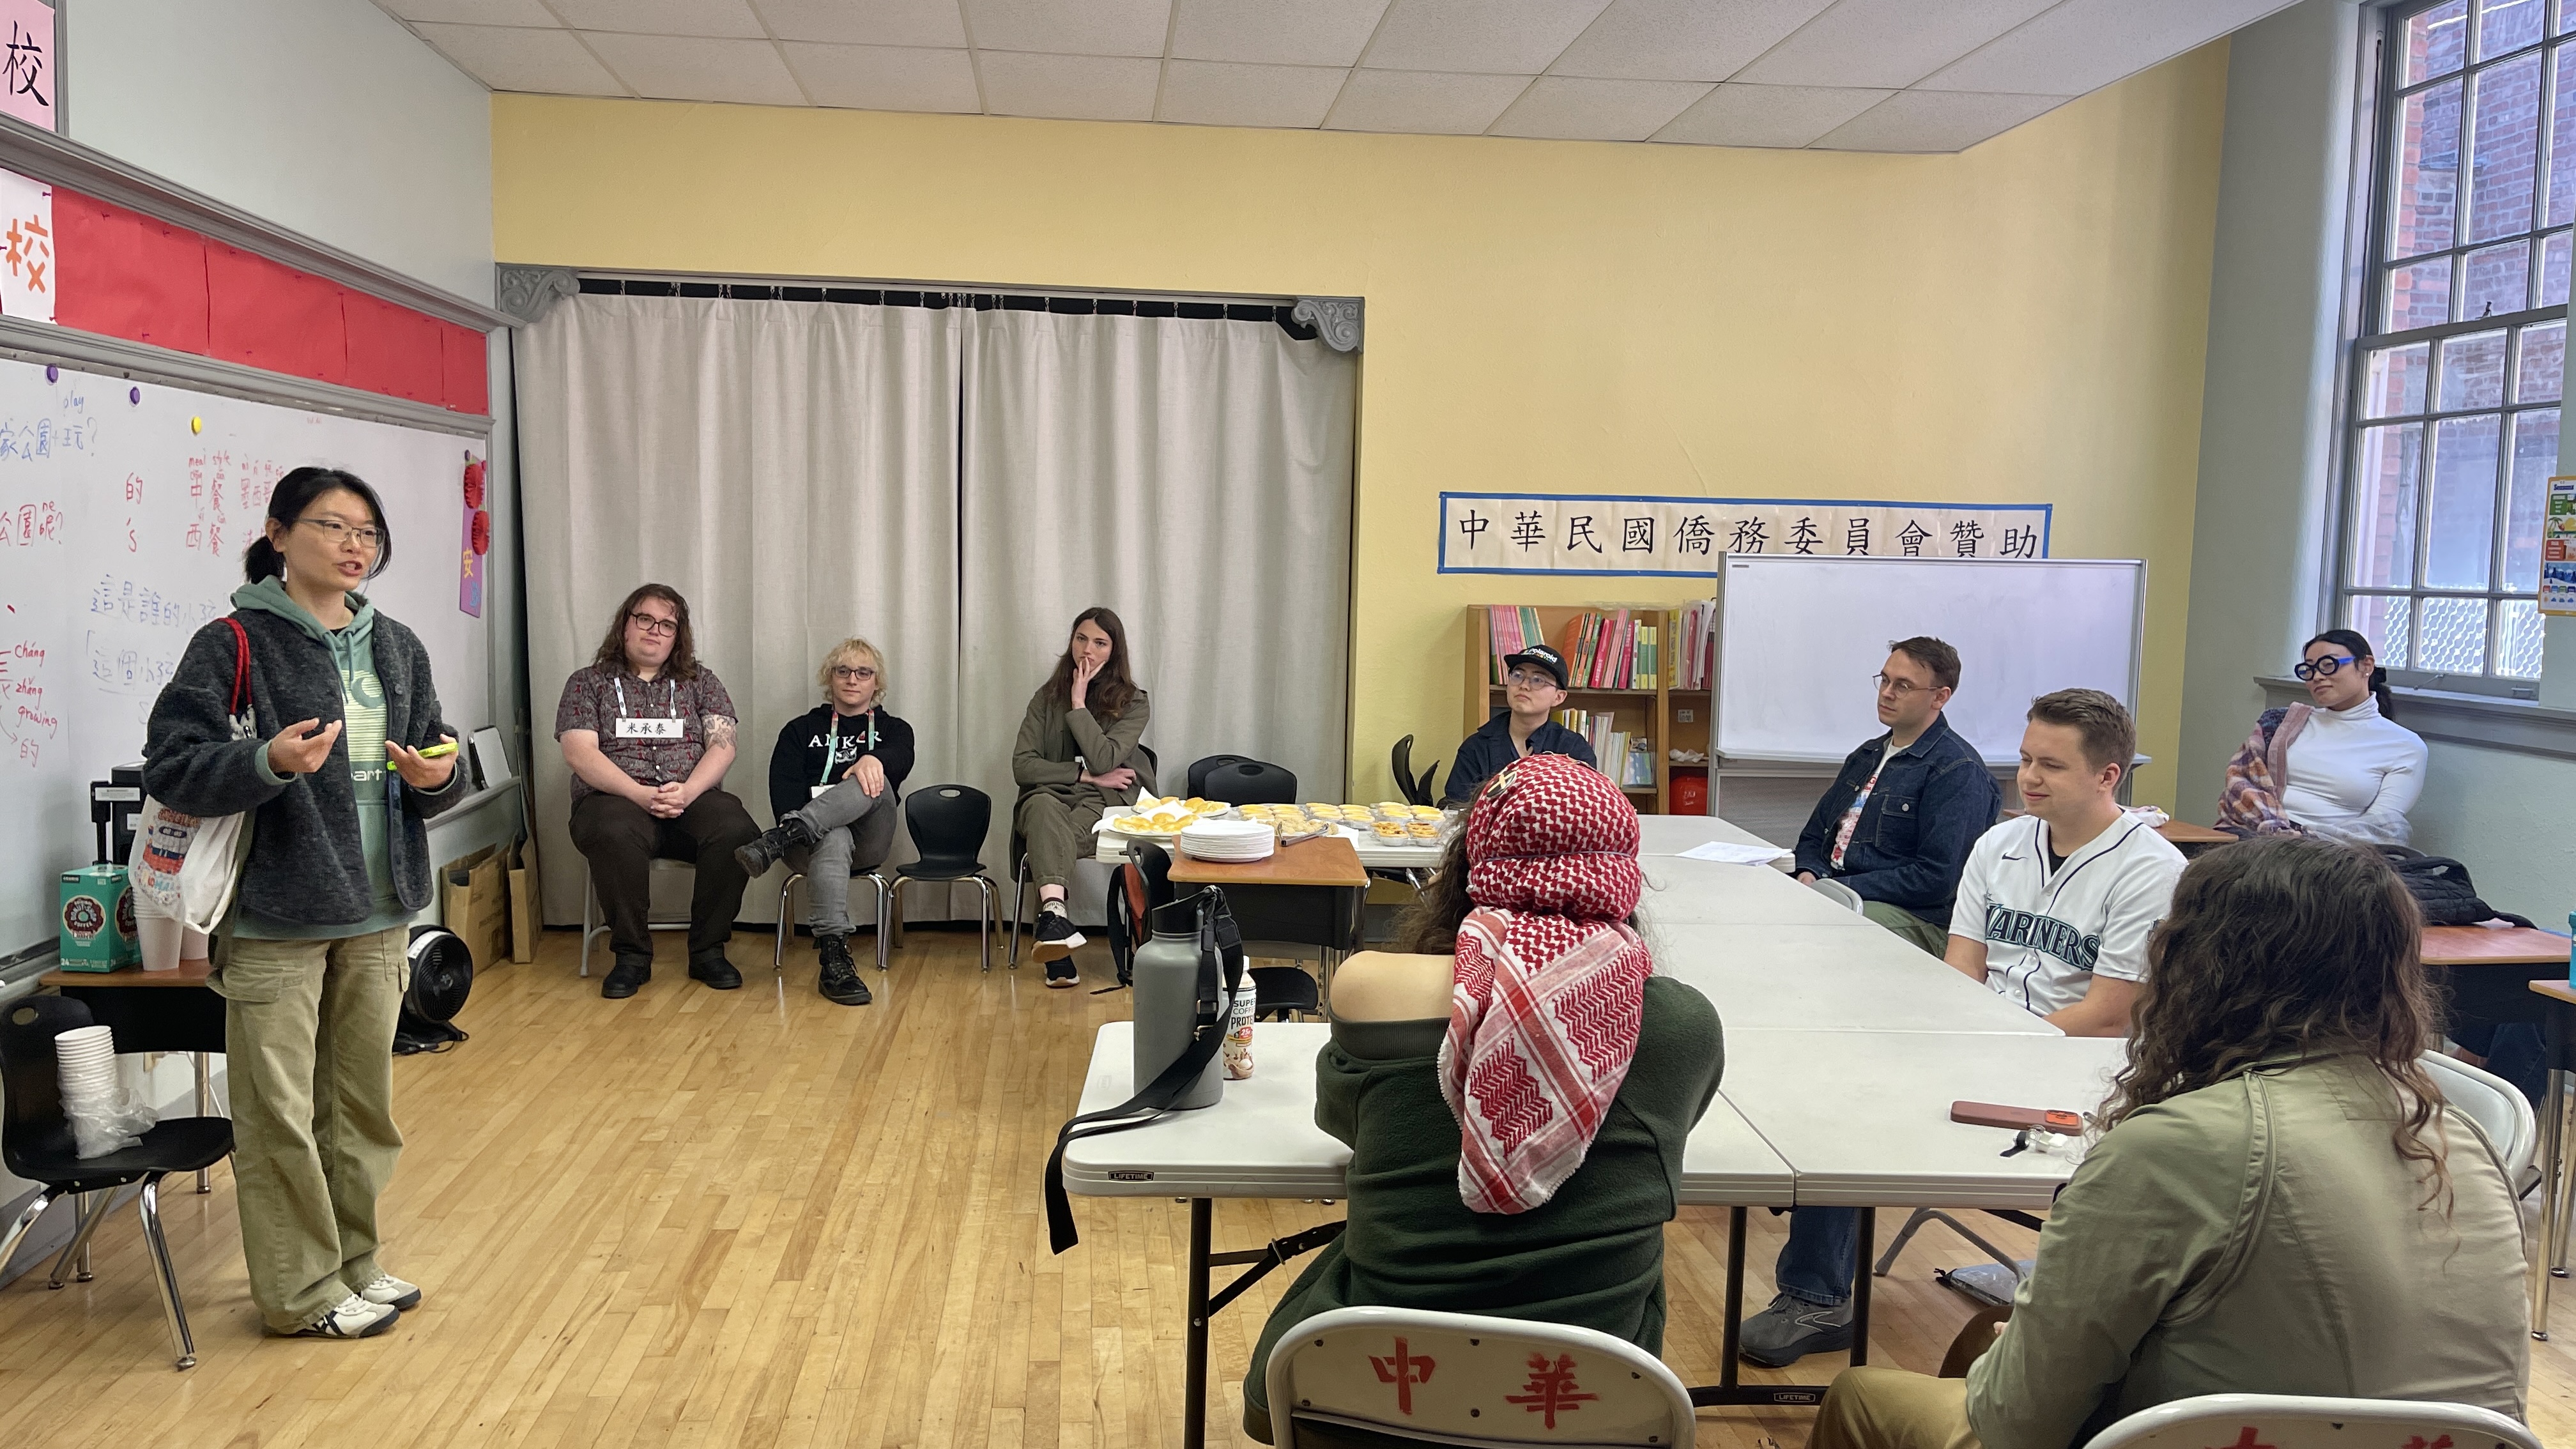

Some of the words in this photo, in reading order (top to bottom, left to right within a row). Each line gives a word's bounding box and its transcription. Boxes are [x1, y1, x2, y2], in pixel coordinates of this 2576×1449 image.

[3, 20, 49, 106] 校
[6, 215, 49, 294] 校
[63, 390, 84, 414] play
[126, 472, 143, 505] 的
[1459, 509, 2038, 558] 中華民國僑務委員會贊助
[626, 722, 666, 735] 米承泰
[20, 739, 39, 767] 的
[351, 769, 383, 781] art
[1233, 1006, 1255, 1015] COFFE
[1368, 1337, 1601, 1430] 中華
